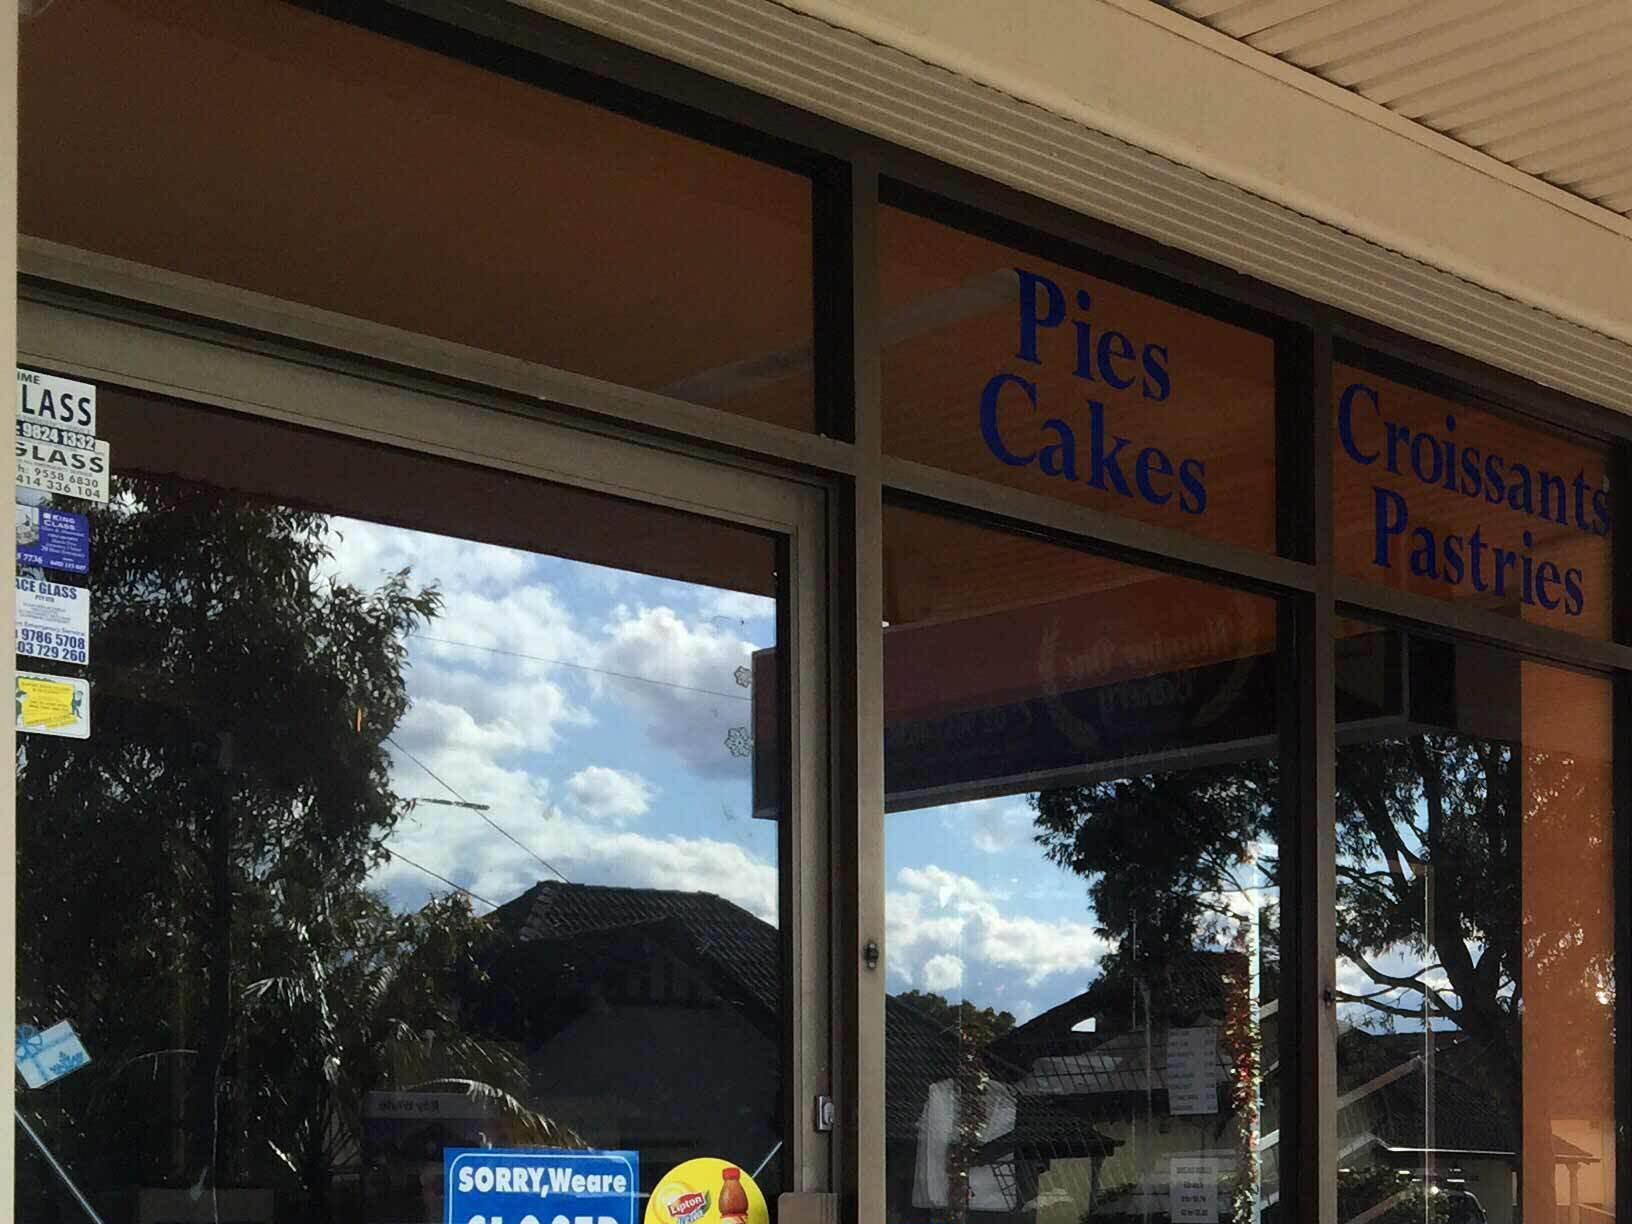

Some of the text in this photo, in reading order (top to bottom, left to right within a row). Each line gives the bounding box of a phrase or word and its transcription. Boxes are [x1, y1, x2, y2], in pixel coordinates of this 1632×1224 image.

[1013, 267, 1172, 402] Pies
[23, 422, 96, 452] 9824 1332
[979, 373, 1207, 516] Cakes
[1338, 382, 1613, 537] Croissants
[34, 467, 65, 481] 9558
[69, 474, 98, 488] 6830
[47, 480, 71, 493] 336
[77, 486, 100, 498] 104
[1372, 486, 1585, 617] Pastries
[39, 581, 77, 600] GLASS
[21, 628, 85, 650] 9786 5708
[37, 644, 59, 658] 729
[62, 648, 86, 663] 260
[670, 1196, 703, 1214] Lipton
